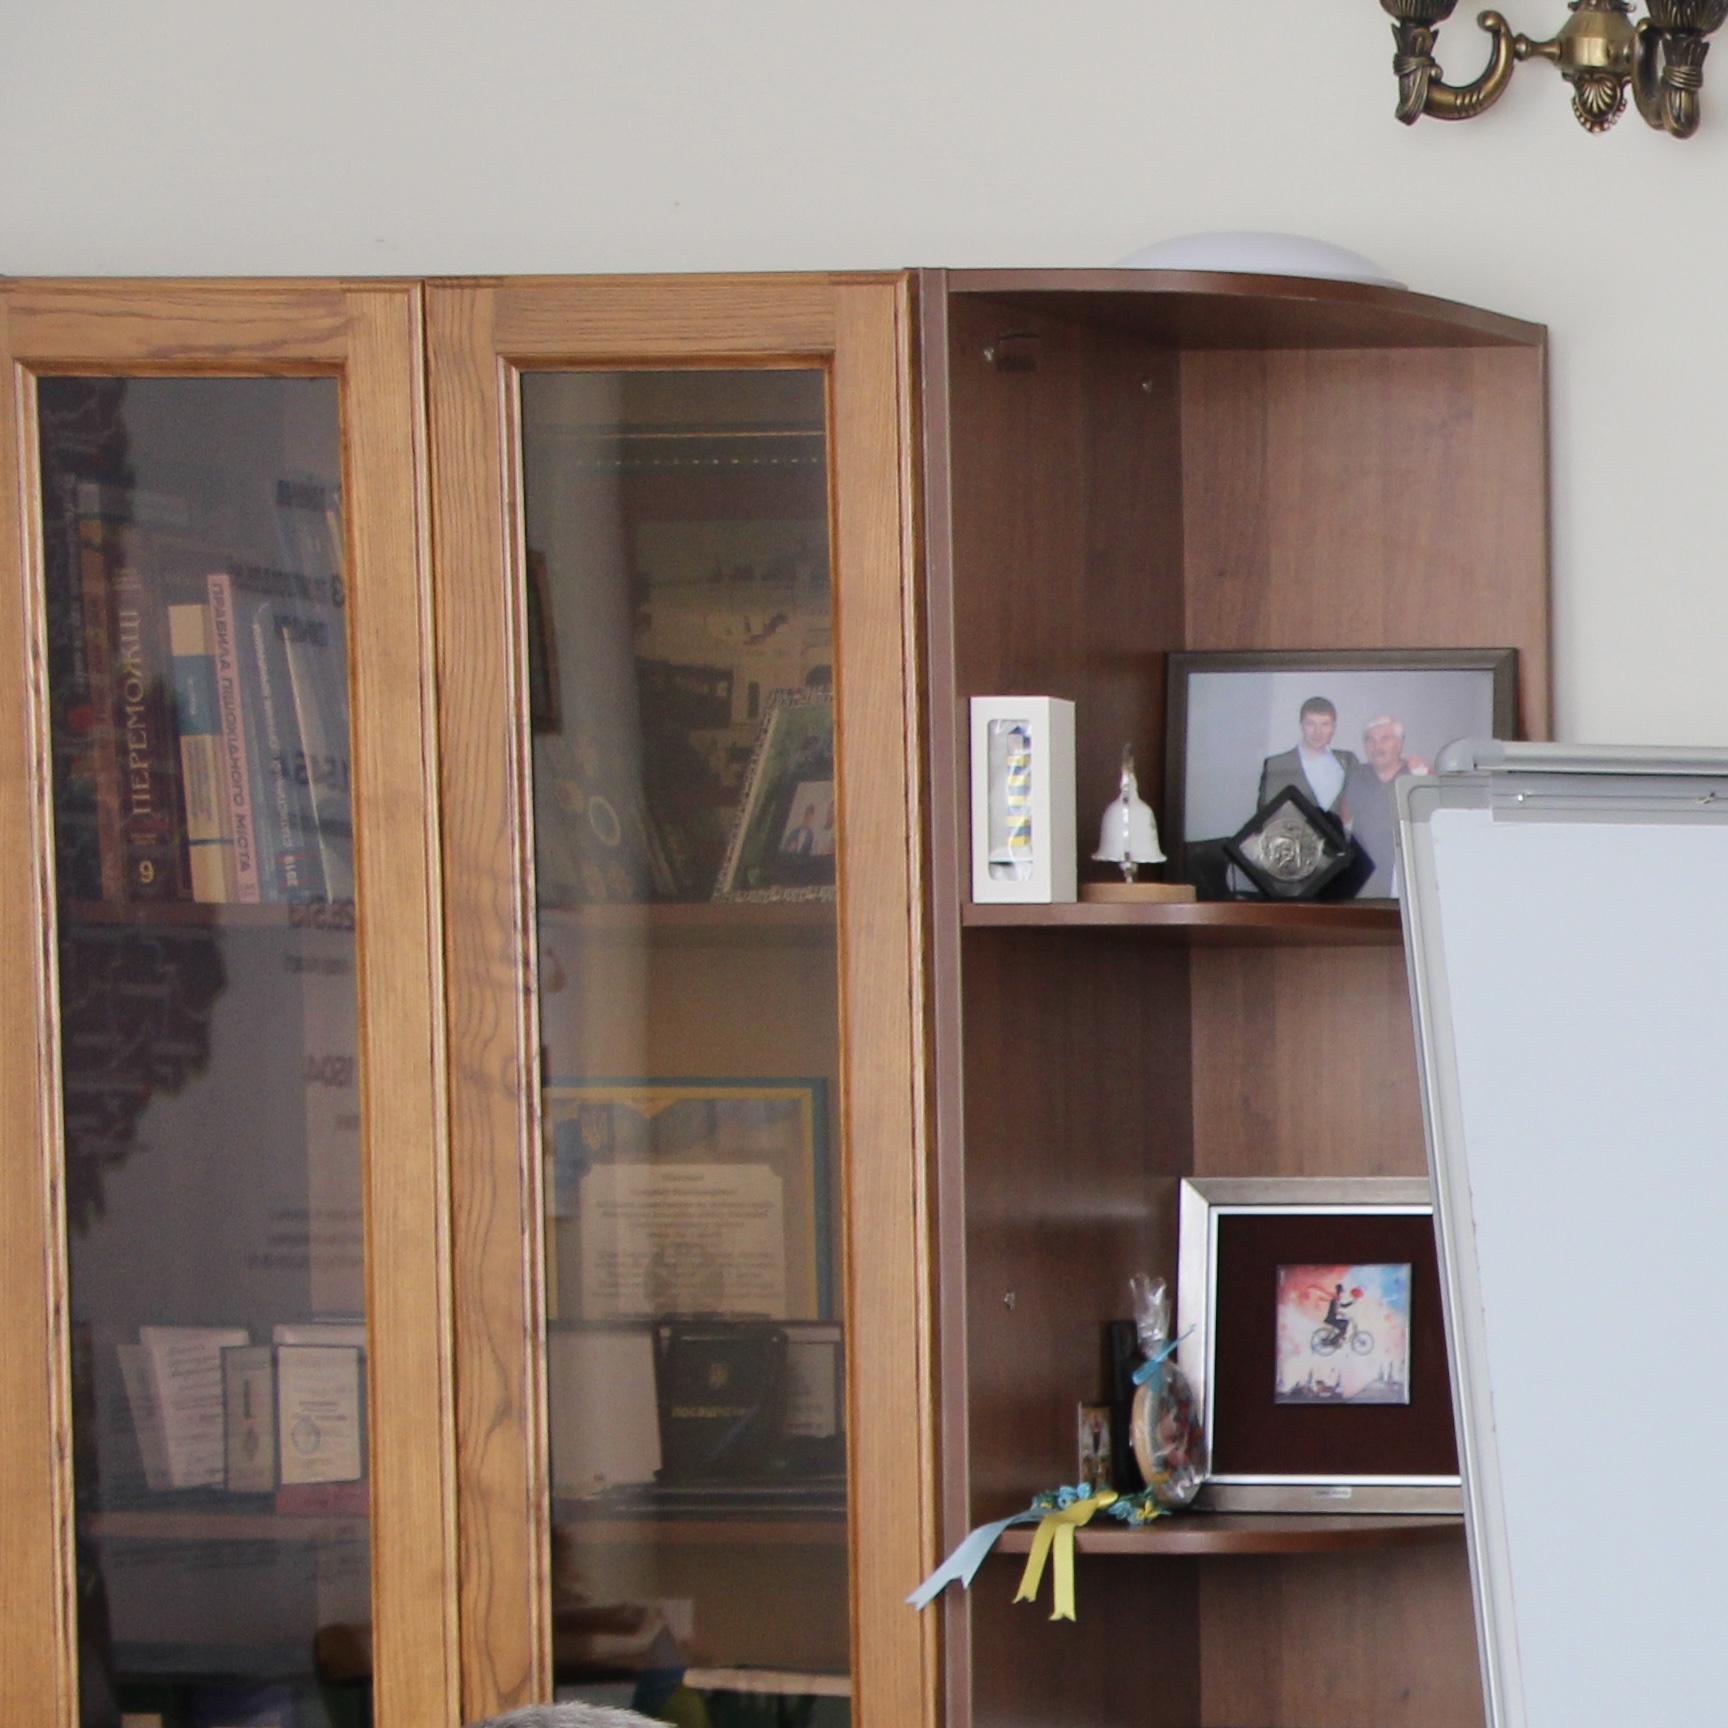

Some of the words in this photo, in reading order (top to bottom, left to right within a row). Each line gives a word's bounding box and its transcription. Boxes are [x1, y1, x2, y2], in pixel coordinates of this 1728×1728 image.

[210, 582, 230, 672] ПРАВИЛА
[118, 609, 152, 817] ПЕРЕМОЖЦІ
[220, 676, 245, 807] ПІШОХІДНОГО
[232, 813, 251, 874] МІСТА
